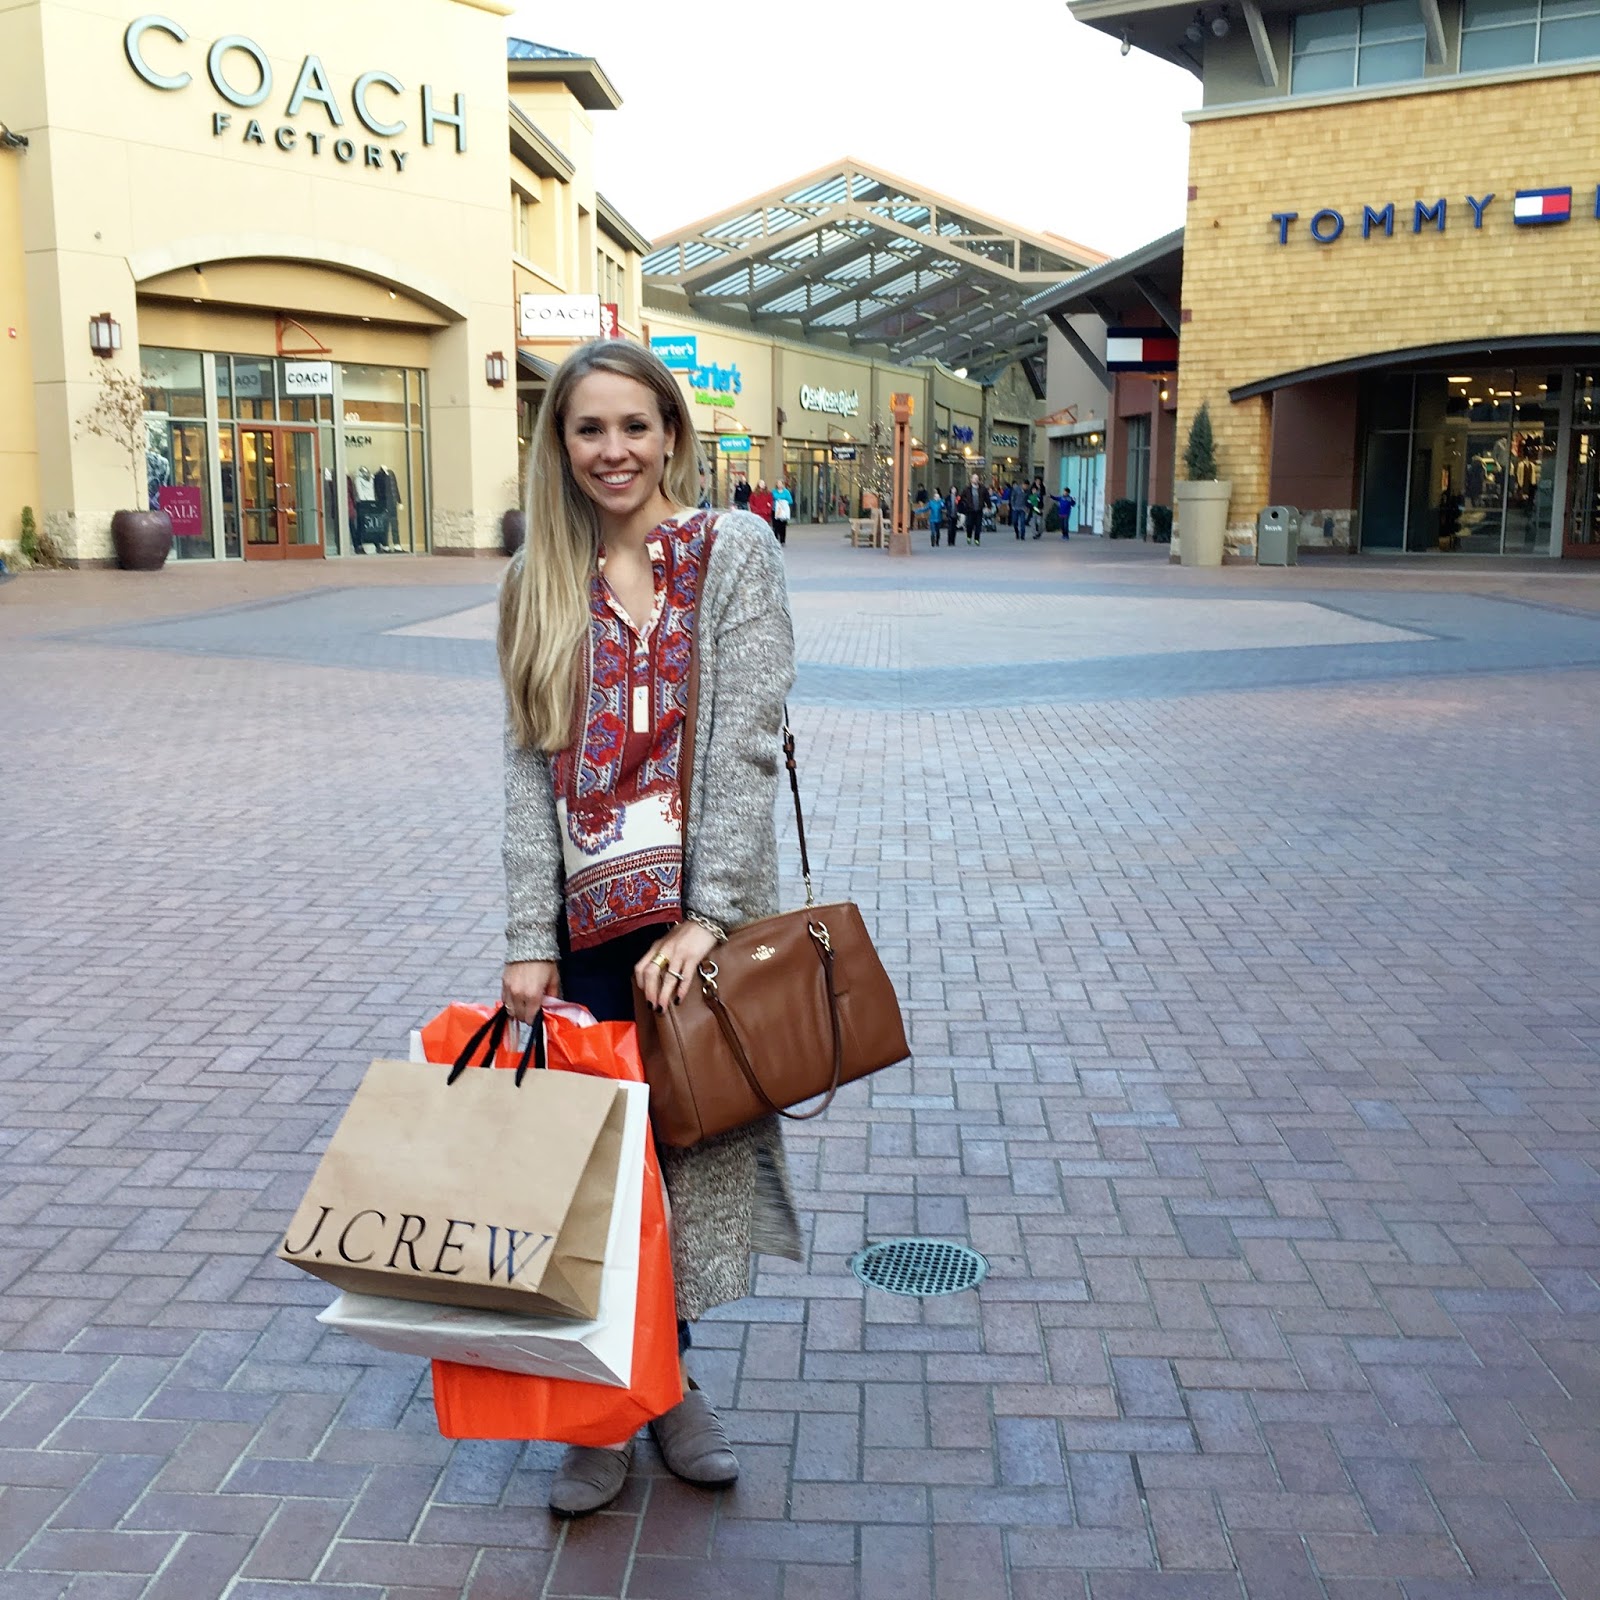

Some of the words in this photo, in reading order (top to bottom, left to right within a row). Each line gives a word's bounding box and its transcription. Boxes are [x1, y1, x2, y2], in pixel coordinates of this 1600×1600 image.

[123, 14, 467, 154] COACH
[213, 112, 409, 173] FACTORY
[1271, 193, 1496, 245] TOMMY
[524, 308, 594, 320] COACH
[652, 342, 695, 356] carter's
[287, 372, 328, 384] COACH
[163, 504, 199, 518] SALE
